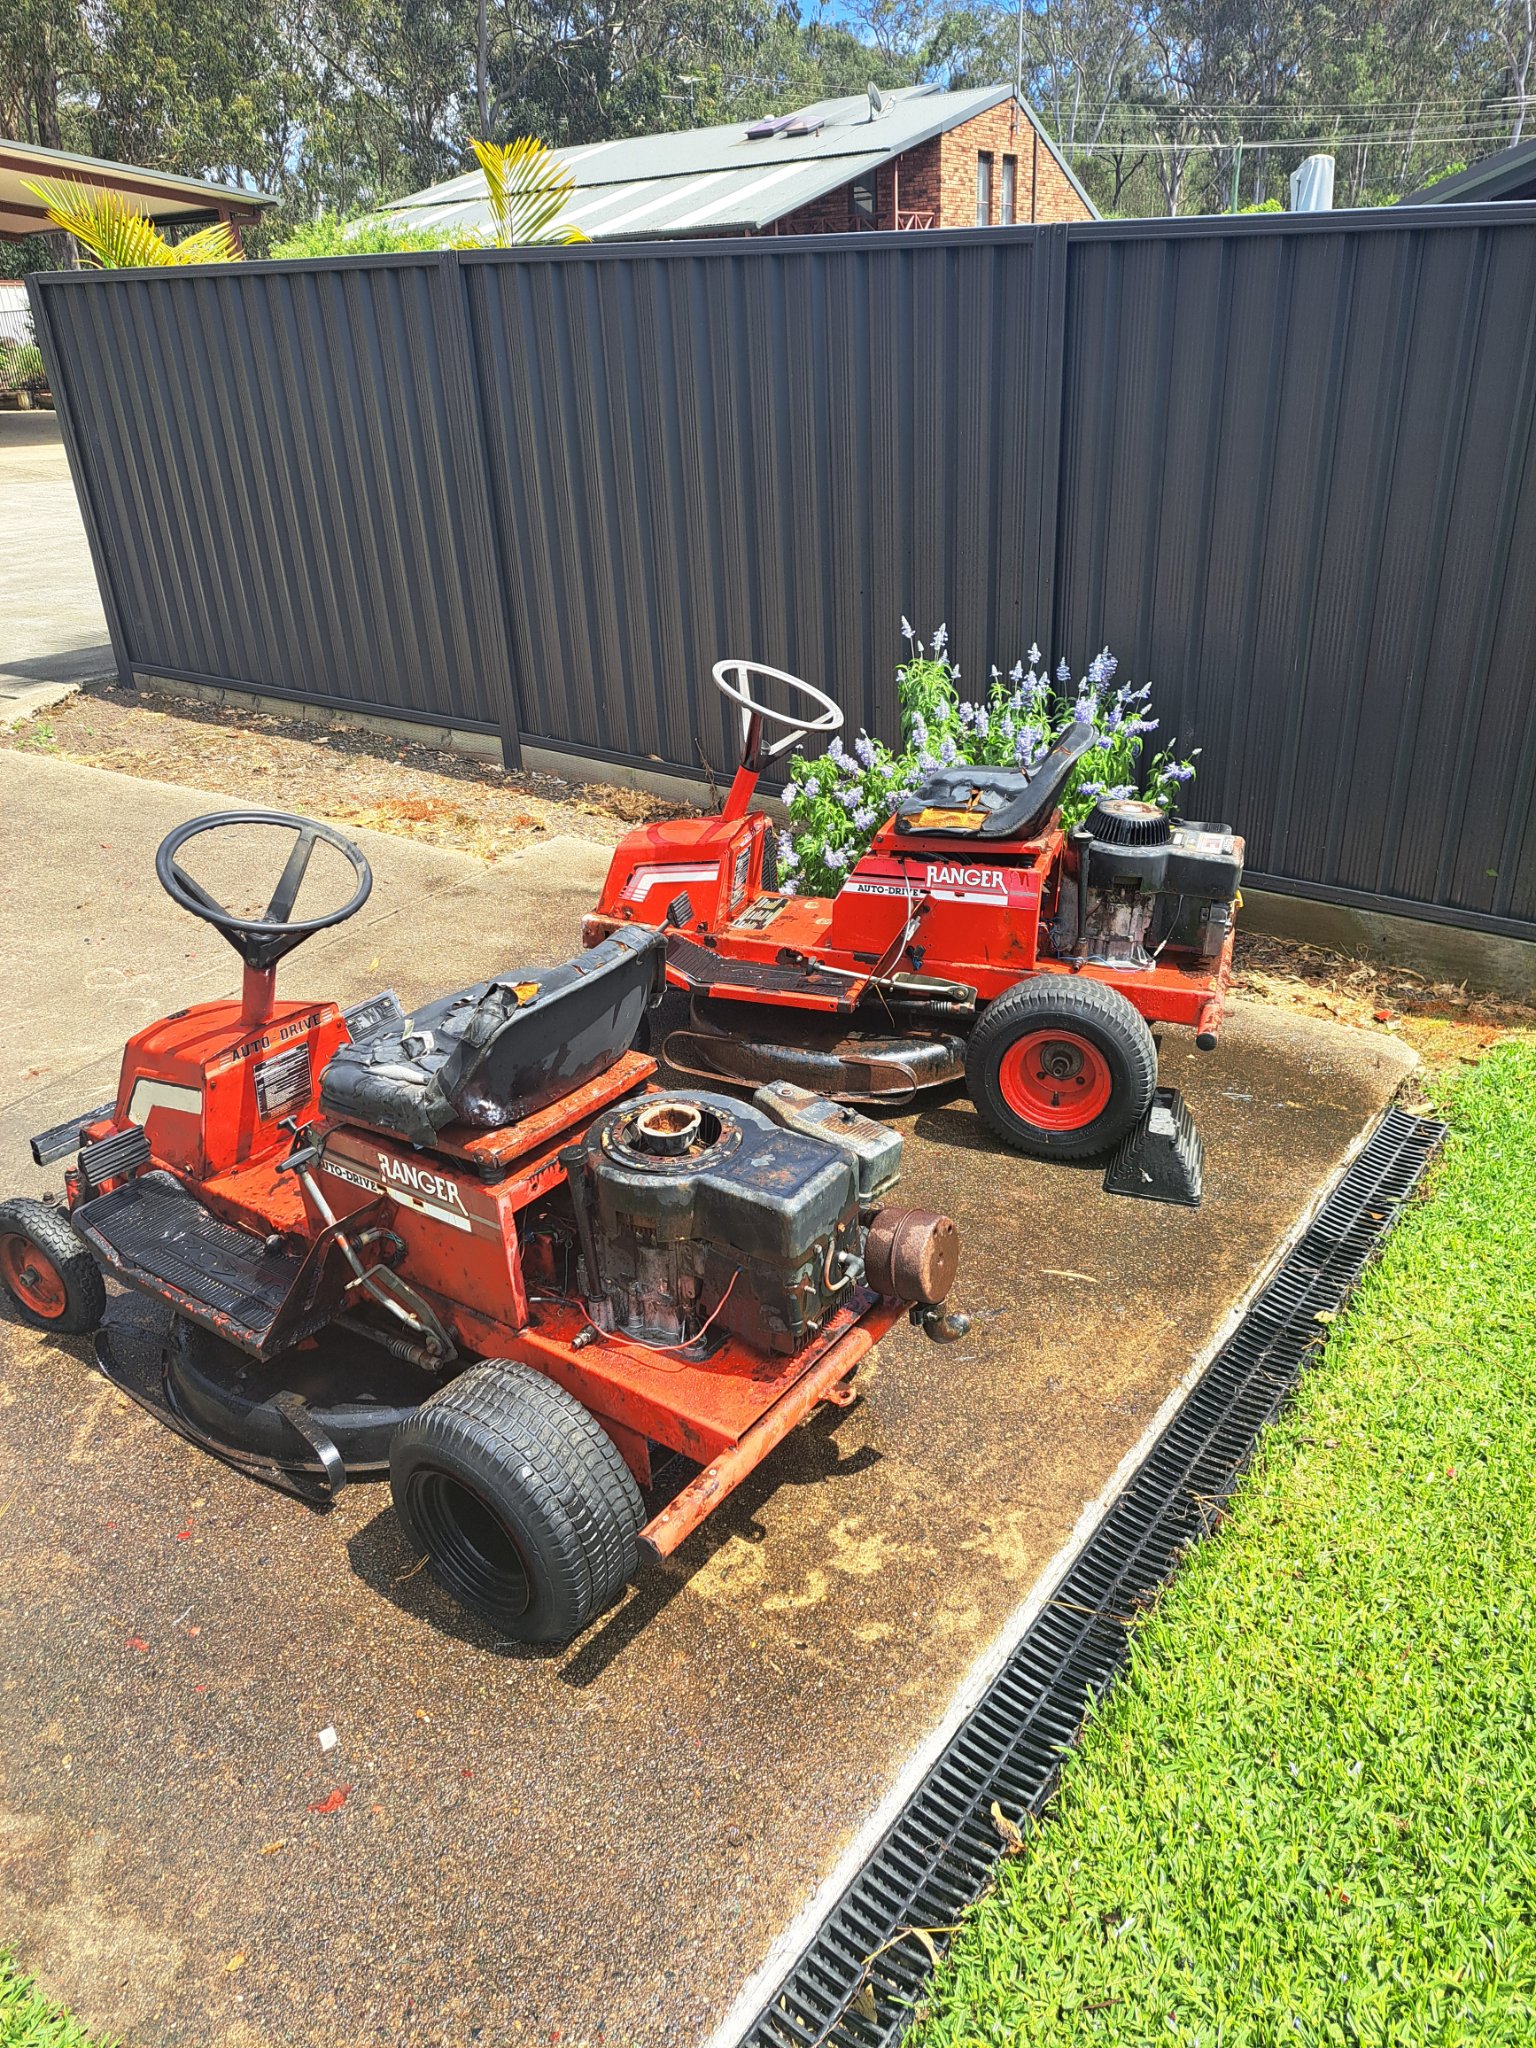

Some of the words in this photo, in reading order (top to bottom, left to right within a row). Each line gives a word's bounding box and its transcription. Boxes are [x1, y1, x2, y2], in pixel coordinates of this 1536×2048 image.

[857, 884, 919, 897] AUTO-DRIVE
[926, 865, 1008, 894] RANGER
[321, 1160, 378, 1191] UTO-DRIVE
[378, 1153, 469, 1217] RANGER
